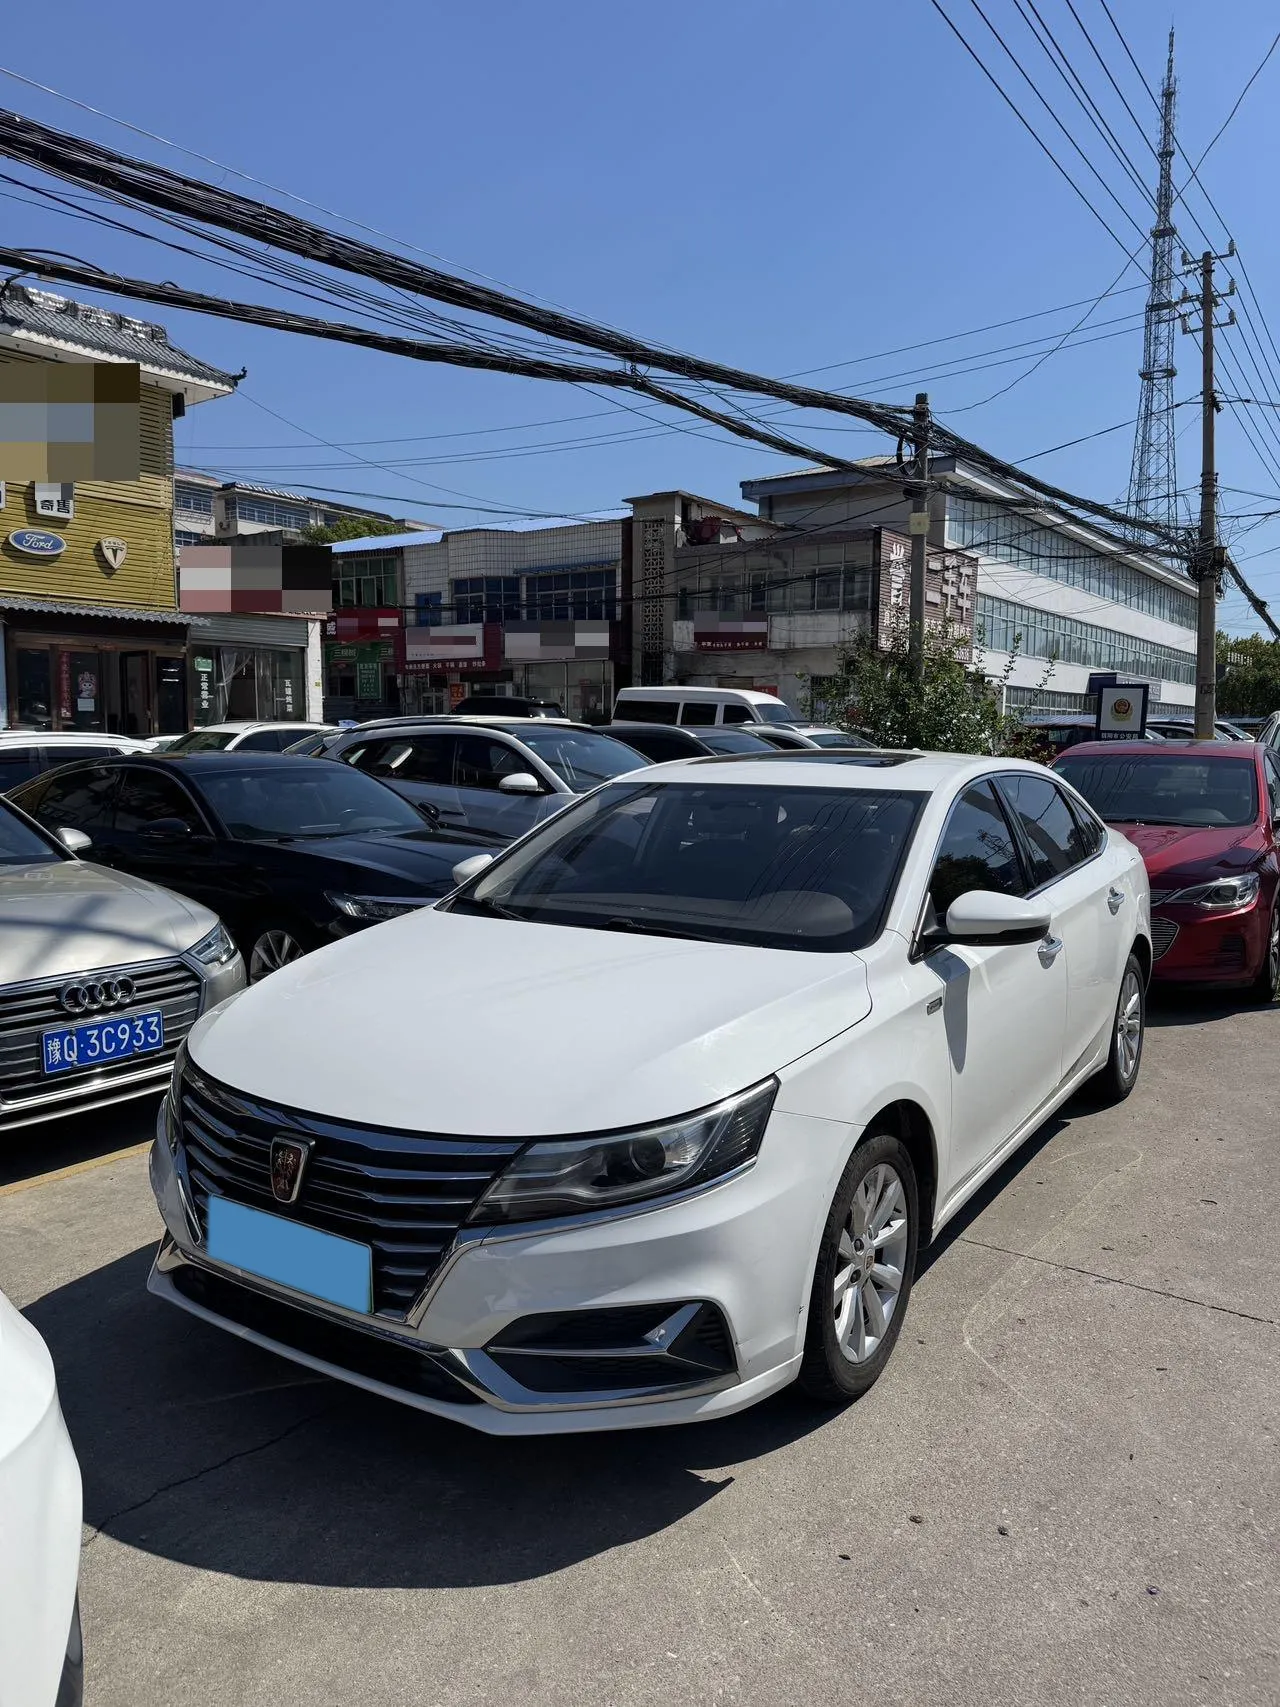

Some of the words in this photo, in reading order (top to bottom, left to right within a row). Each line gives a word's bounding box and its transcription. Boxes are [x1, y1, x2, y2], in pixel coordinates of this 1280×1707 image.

[22, 533, 53, 550] Ford
[200, 673, 209, 709] 正常营业
